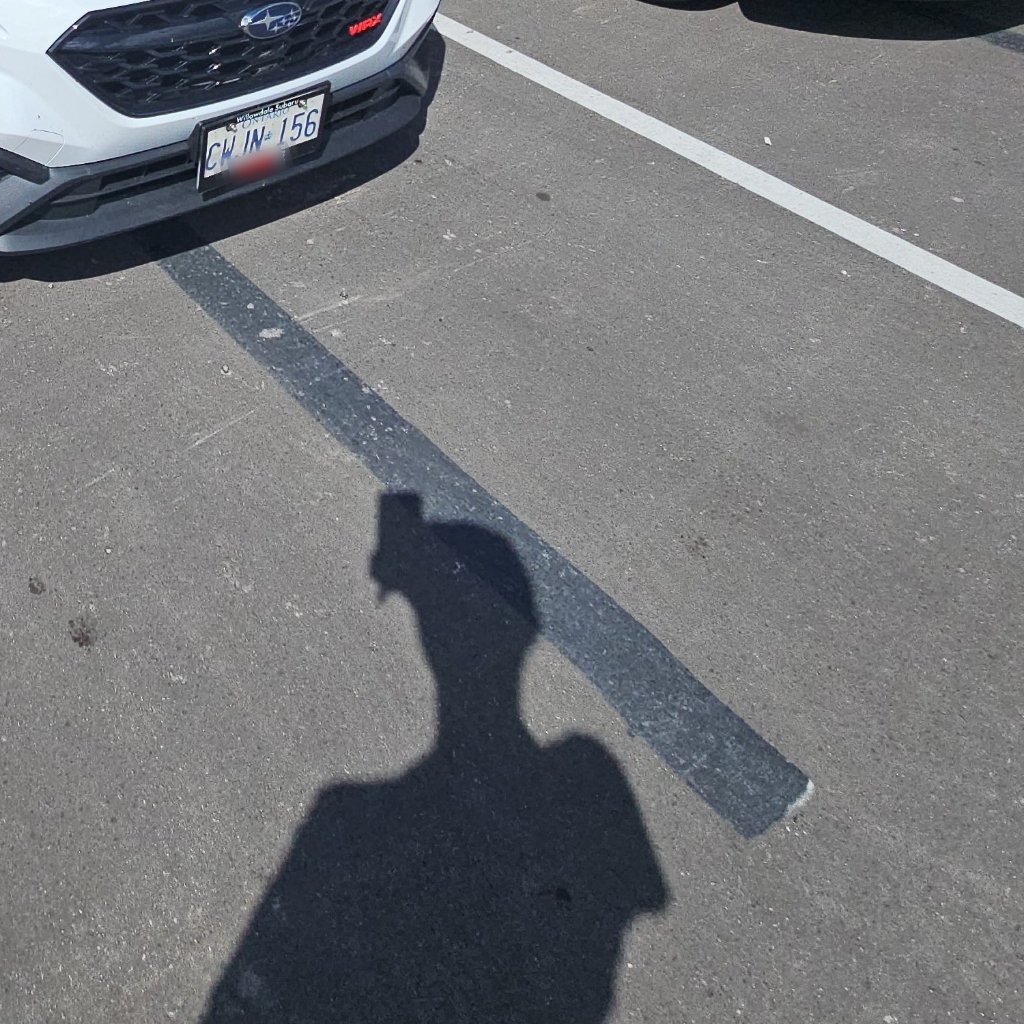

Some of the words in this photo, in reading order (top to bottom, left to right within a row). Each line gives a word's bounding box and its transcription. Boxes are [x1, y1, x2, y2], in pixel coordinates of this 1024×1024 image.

[236, 107, 274, 123] Willowdale
[275, 99, 299, 111] Subaru
[278, 108, 319, 145] 156
